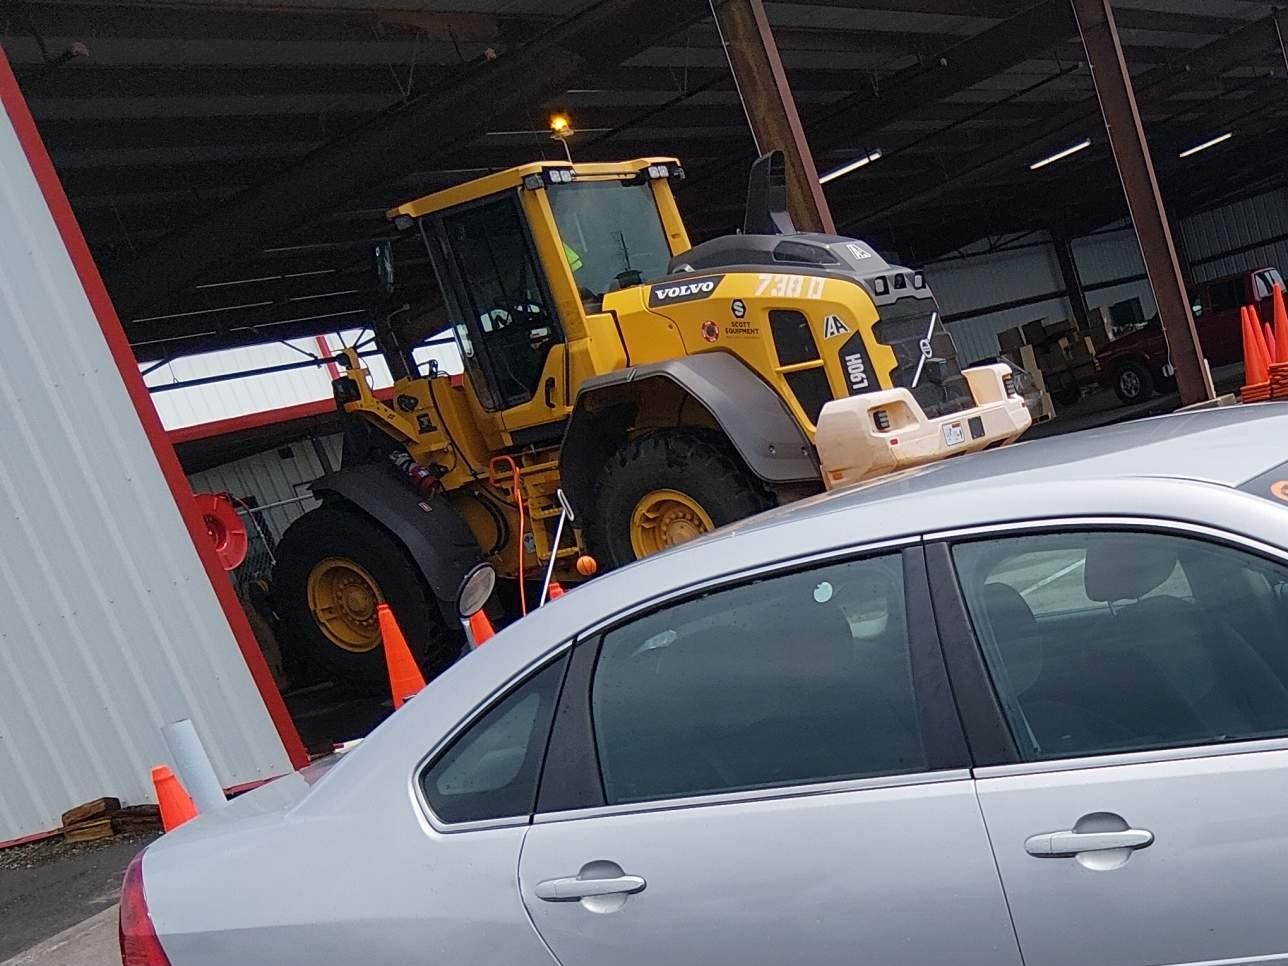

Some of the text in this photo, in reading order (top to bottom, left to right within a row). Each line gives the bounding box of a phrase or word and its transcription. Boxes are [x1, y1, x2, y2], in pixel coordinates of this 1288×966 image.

[655, 281, 715, 300] VOLVO
[725, 327, 760, 335] EQUIPMENT
[845, 353, 869, 390] L90H
